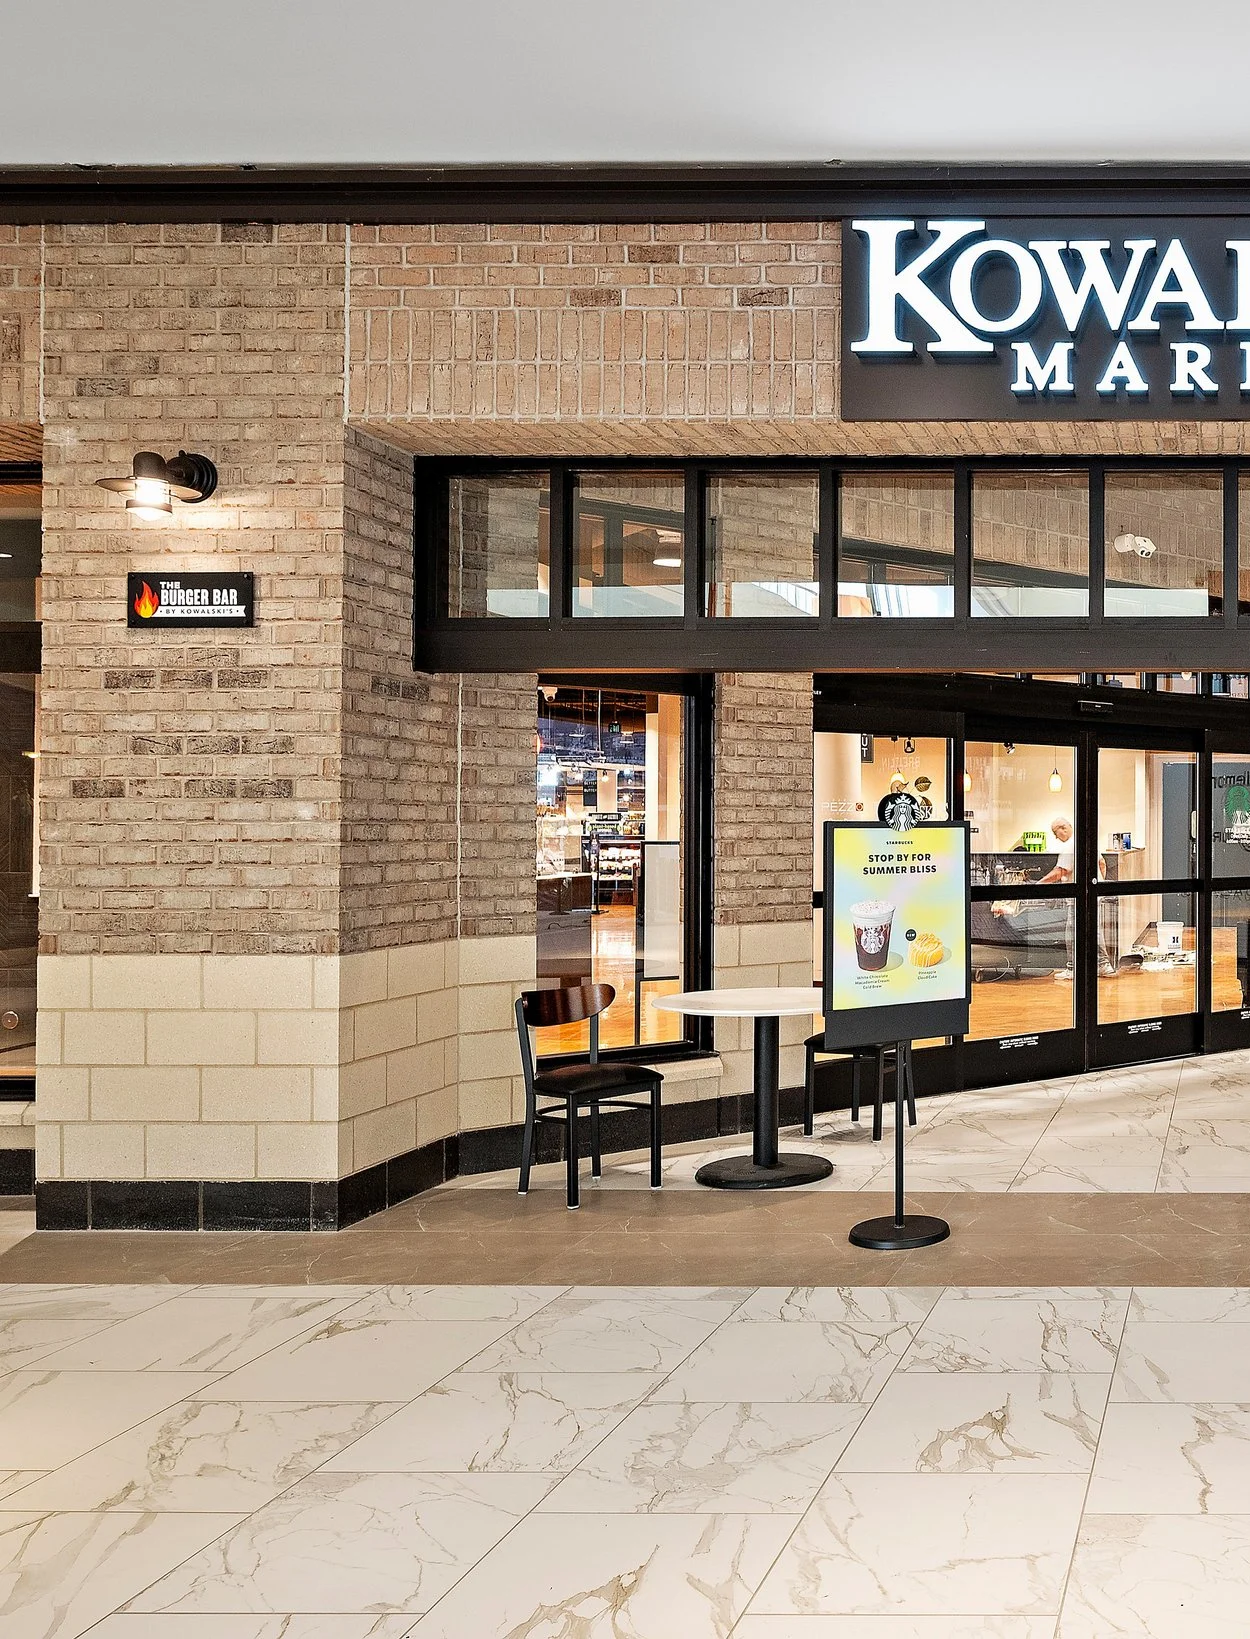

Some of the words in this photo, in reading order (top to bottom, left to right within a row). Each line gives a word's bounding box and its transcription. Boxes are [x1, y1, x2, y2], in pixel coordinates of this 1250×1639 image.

[160, 581, 181, 589] THE
[160, 589, 209, 605] BURGER
[212, 588, 238, 605] BAR
[868, 854, 894, 862] STOP
[896, 854, 909, 862] BY
[911, 853, 931, 861] FOR
[863, 865, 907, 875] SUMMER
[909, 864, 937, 874] BLISS
